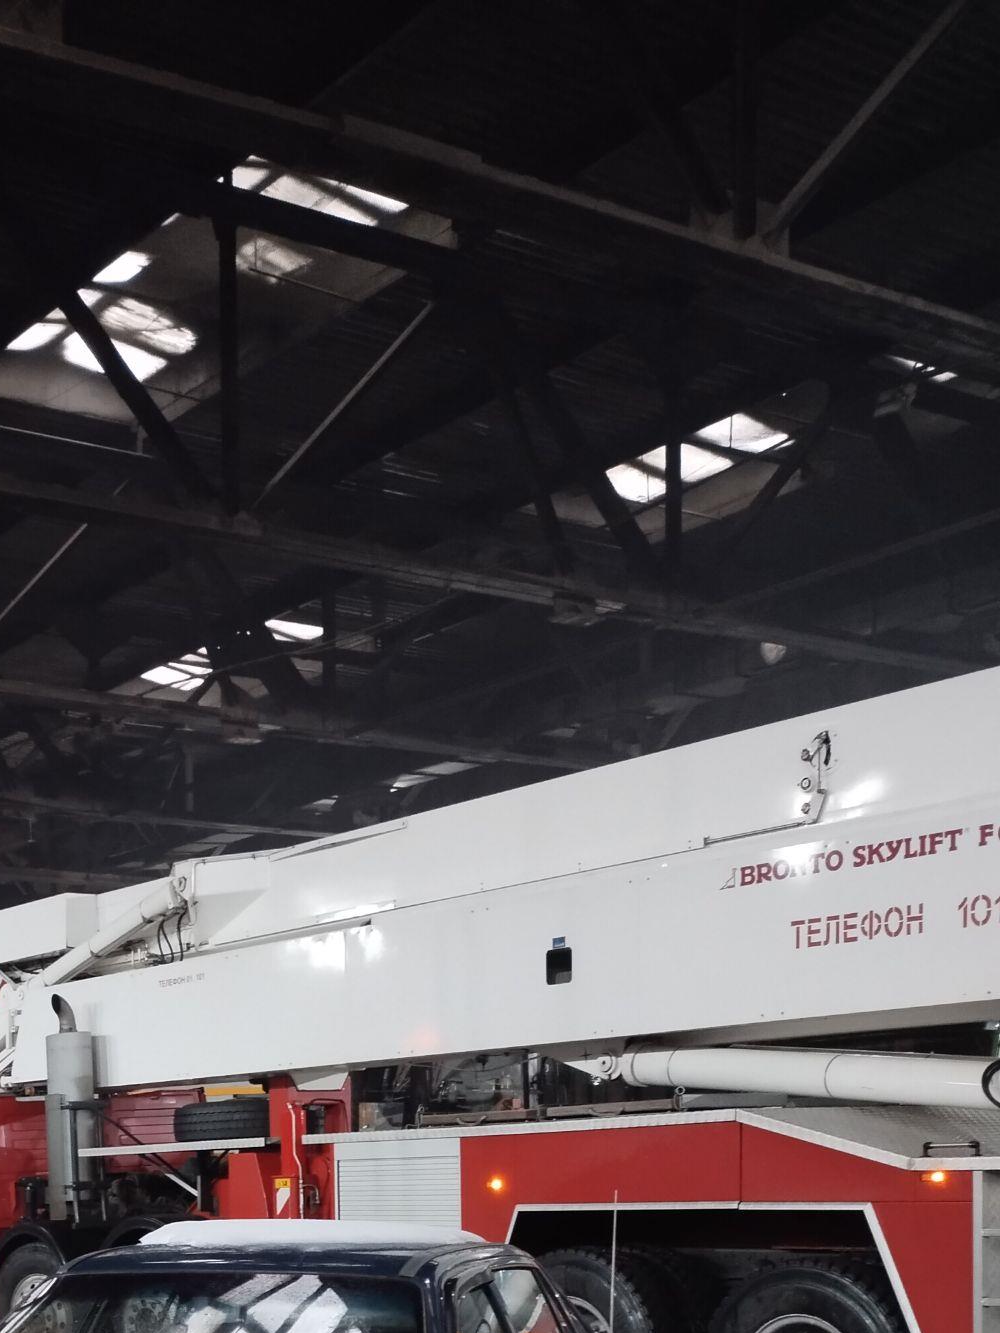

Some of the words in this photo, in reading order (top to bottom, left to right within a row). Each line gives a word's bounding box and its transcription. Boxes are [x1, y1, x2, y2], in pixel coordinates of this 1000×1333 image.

[852, 828, 963, 868] SKYLIFT
[978, 823, 1000, 847] F
[791, 903, 924, 949] ТЕЛЕФОН
